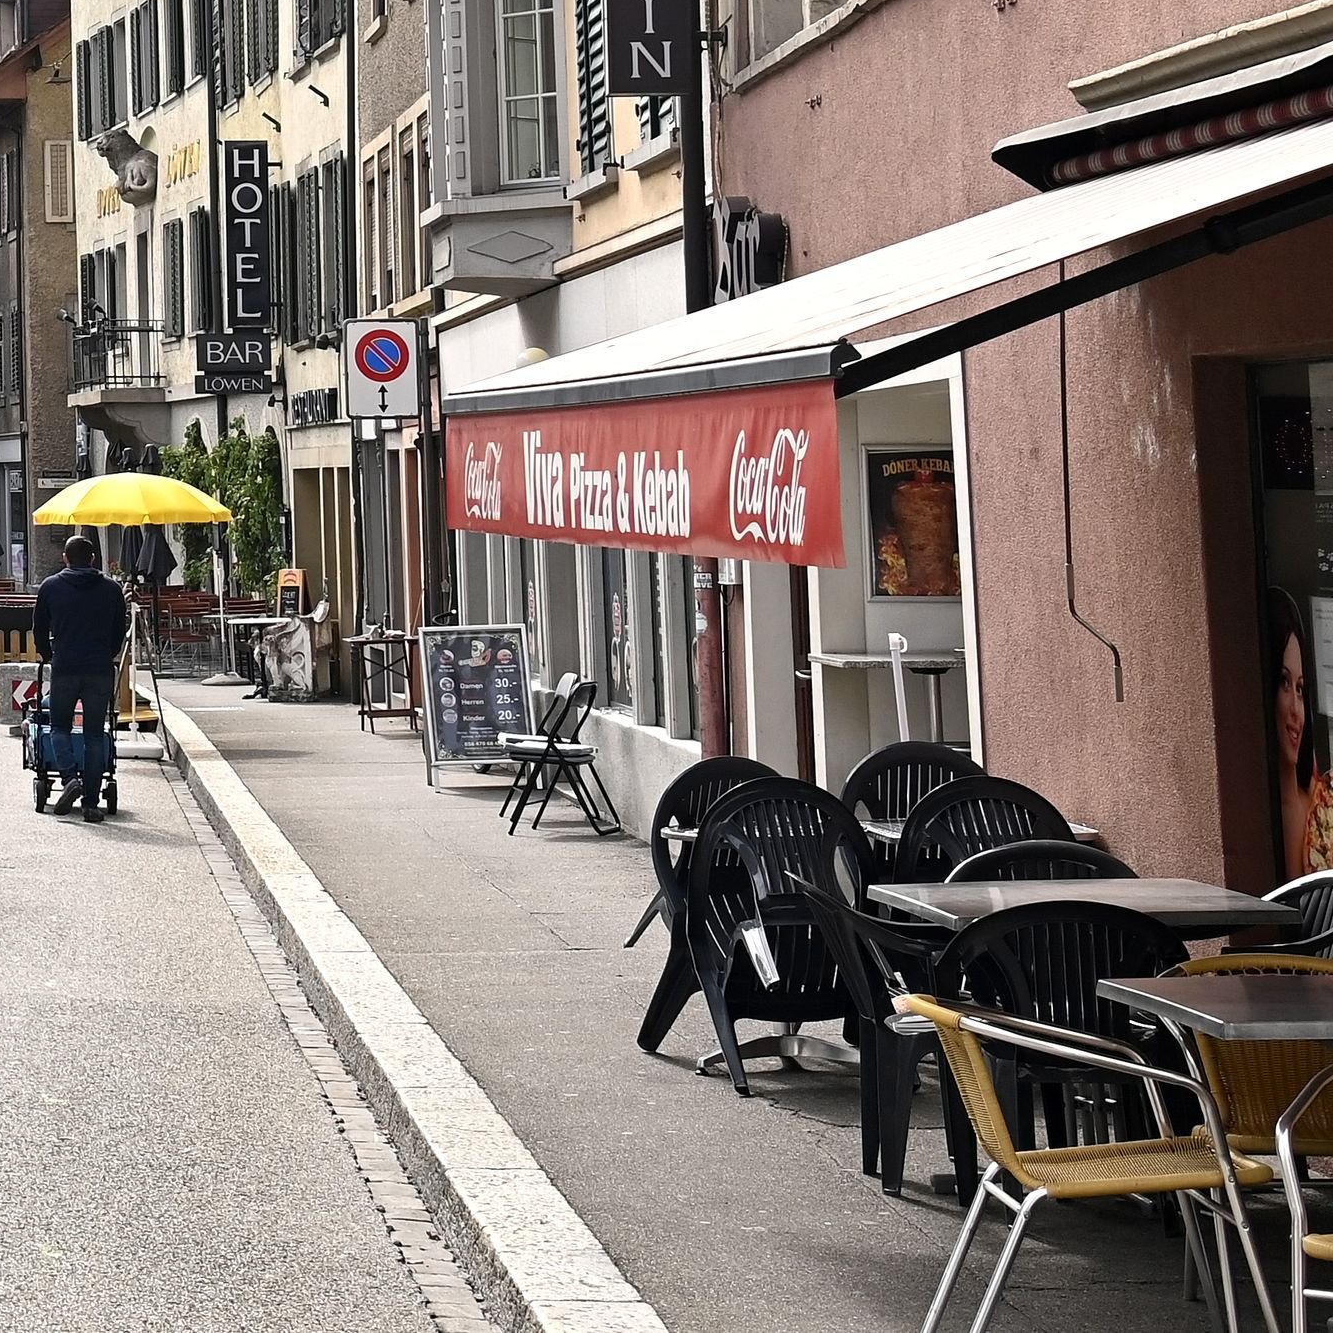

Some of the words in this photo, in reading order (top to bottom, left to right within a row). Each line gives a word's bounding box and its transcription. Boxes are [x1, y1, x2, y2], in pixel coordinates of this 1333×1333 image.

[231, 148, 263, 318] HOTEL
[205, 340, 265, 364] BAR
[203, 375, 265, 392] LÖWEN
[523, 430, 565, 530] Viva
[569, 452, 613, 532] Pizza
[617, 450, 631, 534] &
[633, 450, 691, 540] Kebab
[459, 682, 484, 690] Damen
